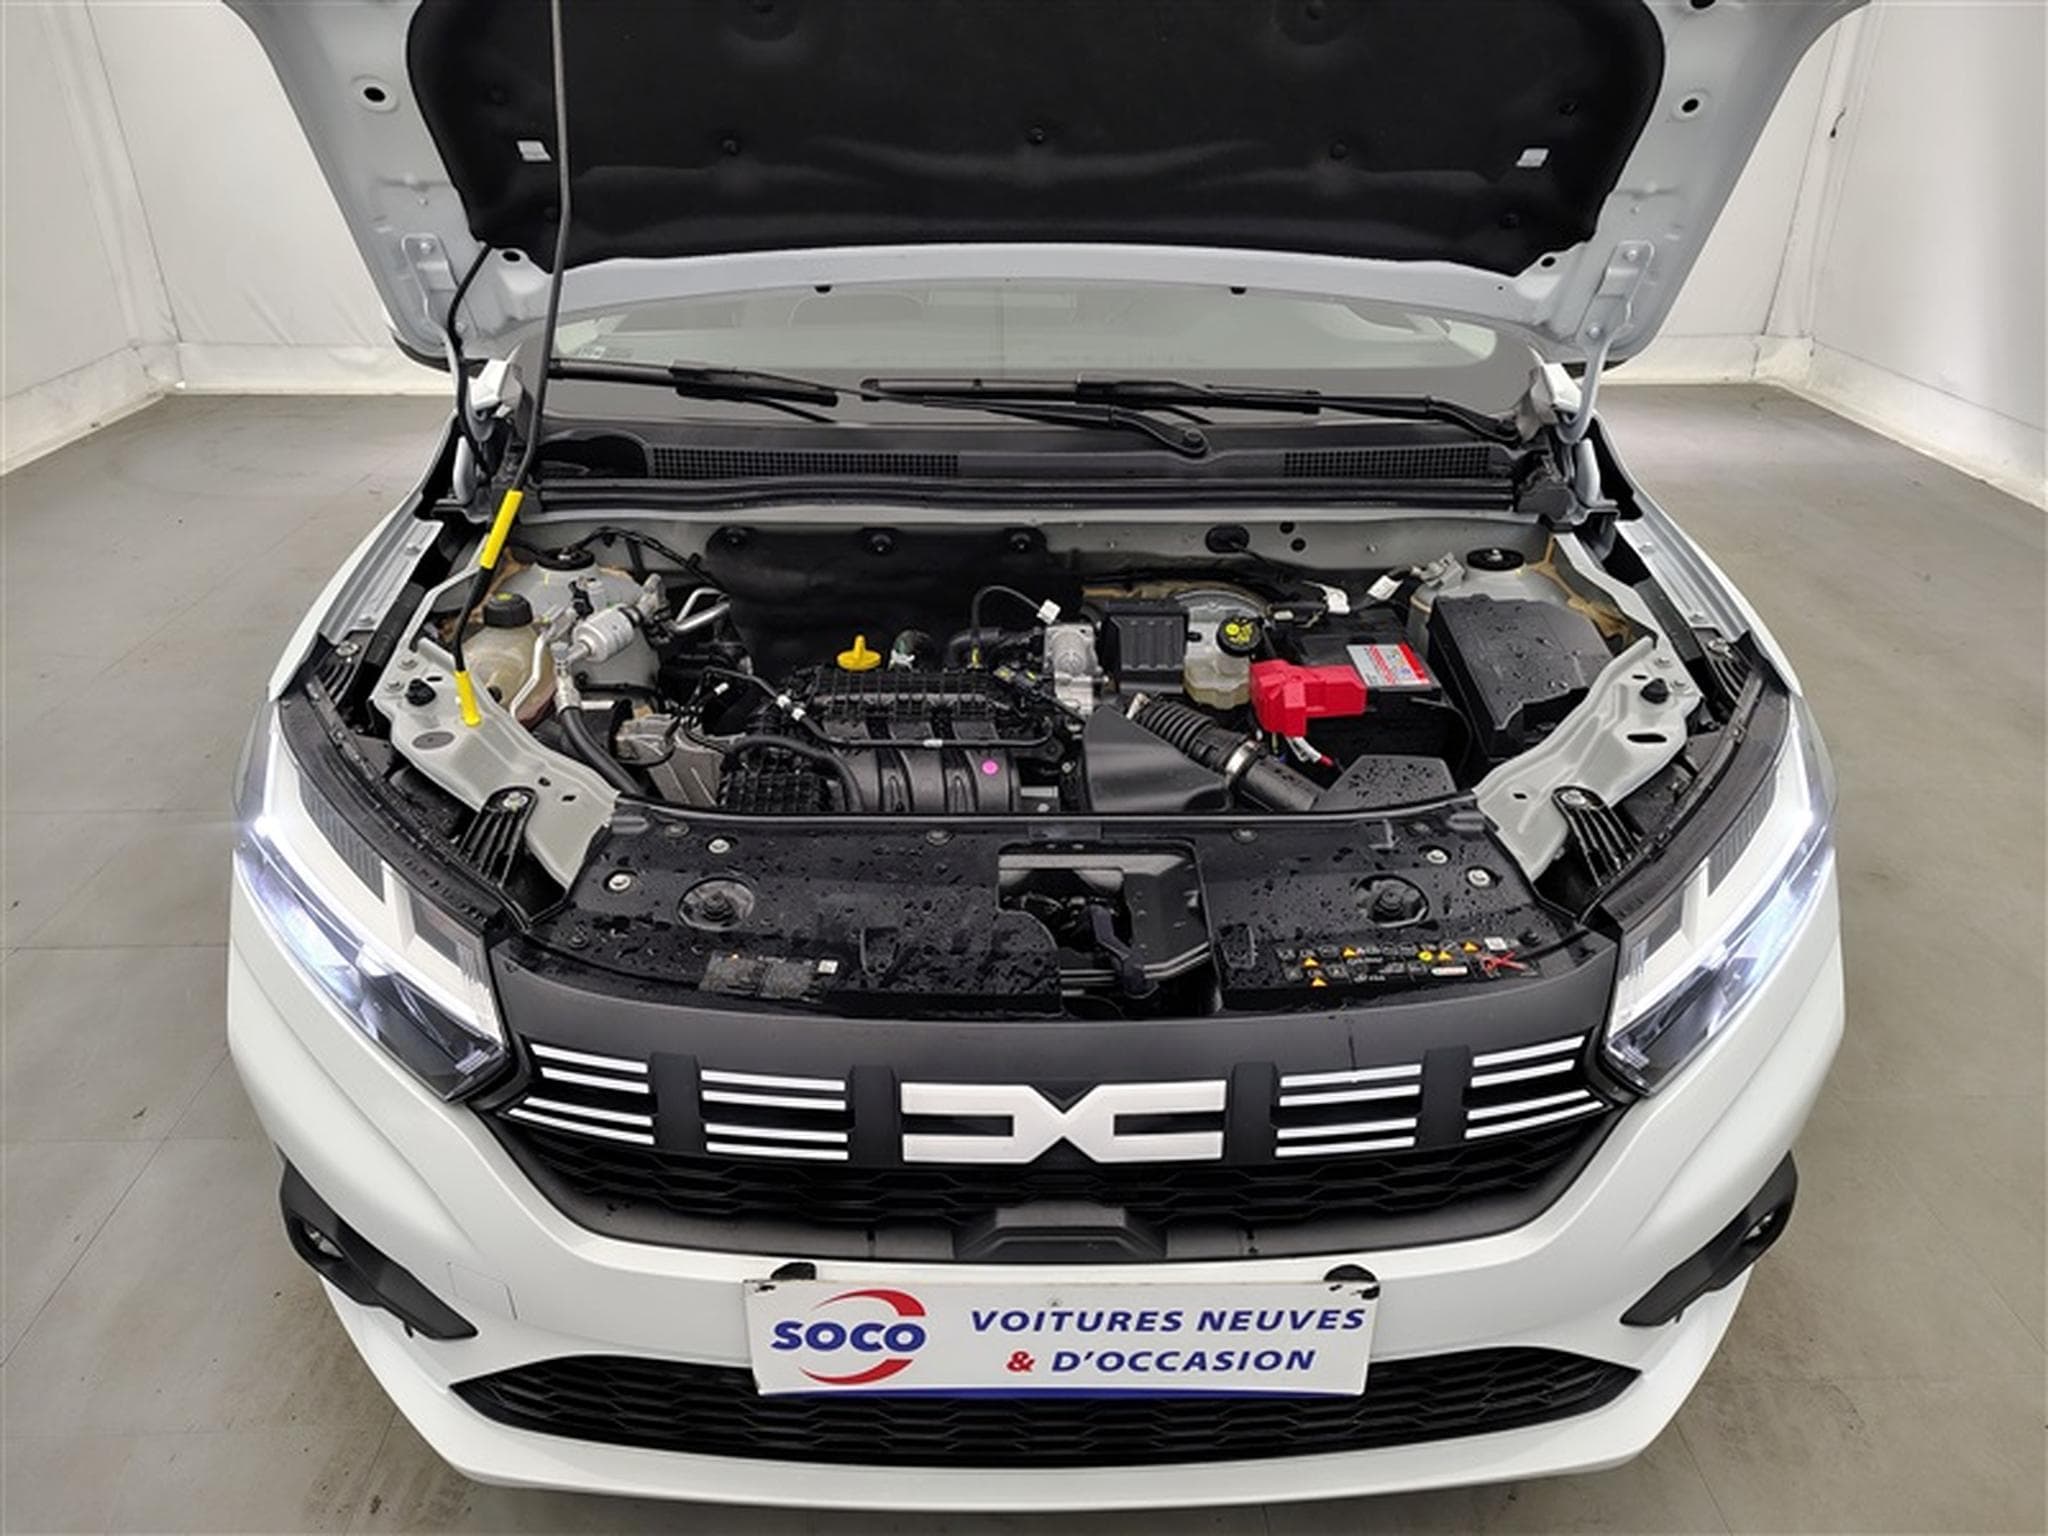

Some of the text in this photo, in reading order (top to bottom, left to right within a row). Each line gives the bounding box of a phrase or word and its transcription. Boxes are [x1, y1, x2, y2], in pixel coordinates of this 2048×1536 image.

[971, 1310, 1366, 1333] VOITURES NEUVES
[771, 1321, 927, 1352] SOCO
[1006, 1349, 1315, 1373] & D'OCCASION
